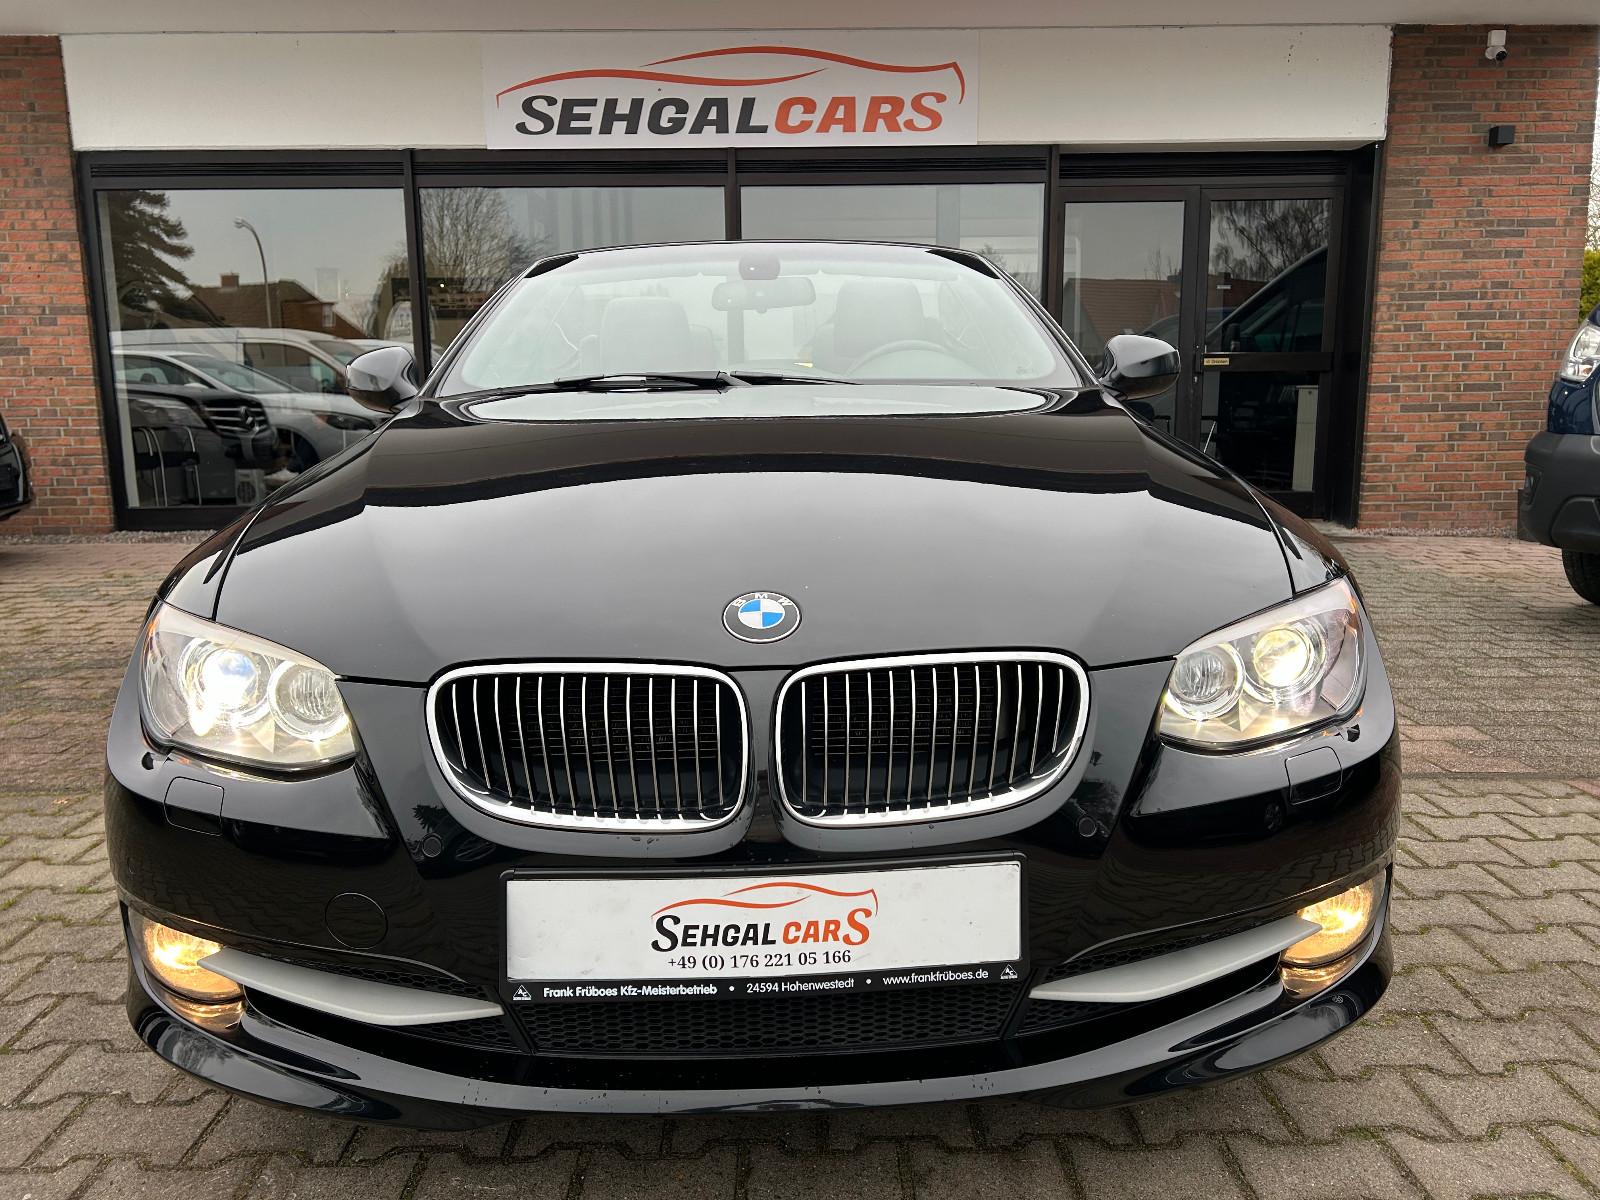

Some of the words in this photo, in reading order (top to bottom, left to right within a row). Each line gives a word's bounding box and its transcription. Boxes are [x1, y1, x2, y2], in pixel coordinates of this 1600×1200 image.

[731, 592, 793, 607] BMW
[651, 914, 777, 953] SEHGAL
[782, 907, 872, 946] CARS
[667, 955, 697, 969] +49
[701, 955, 725, 971] (0)
[730, 954, 760, 969] 176
[764, 953, 792, 968] 221
[798, 952, 817, 966] 05
[822, 949, 852, 965] 166
[543, 986, 574, 998] Frank
[575, 985, 618, 997] Früboes
[620, 983, 718, 997] Kfz-Meisterbetrieb
[746, 982, 779, 994] 24594
[781, 978, 855, 992] Hohenwestedt
[883, 968, 989, 985] www.frankfrüboes.de
